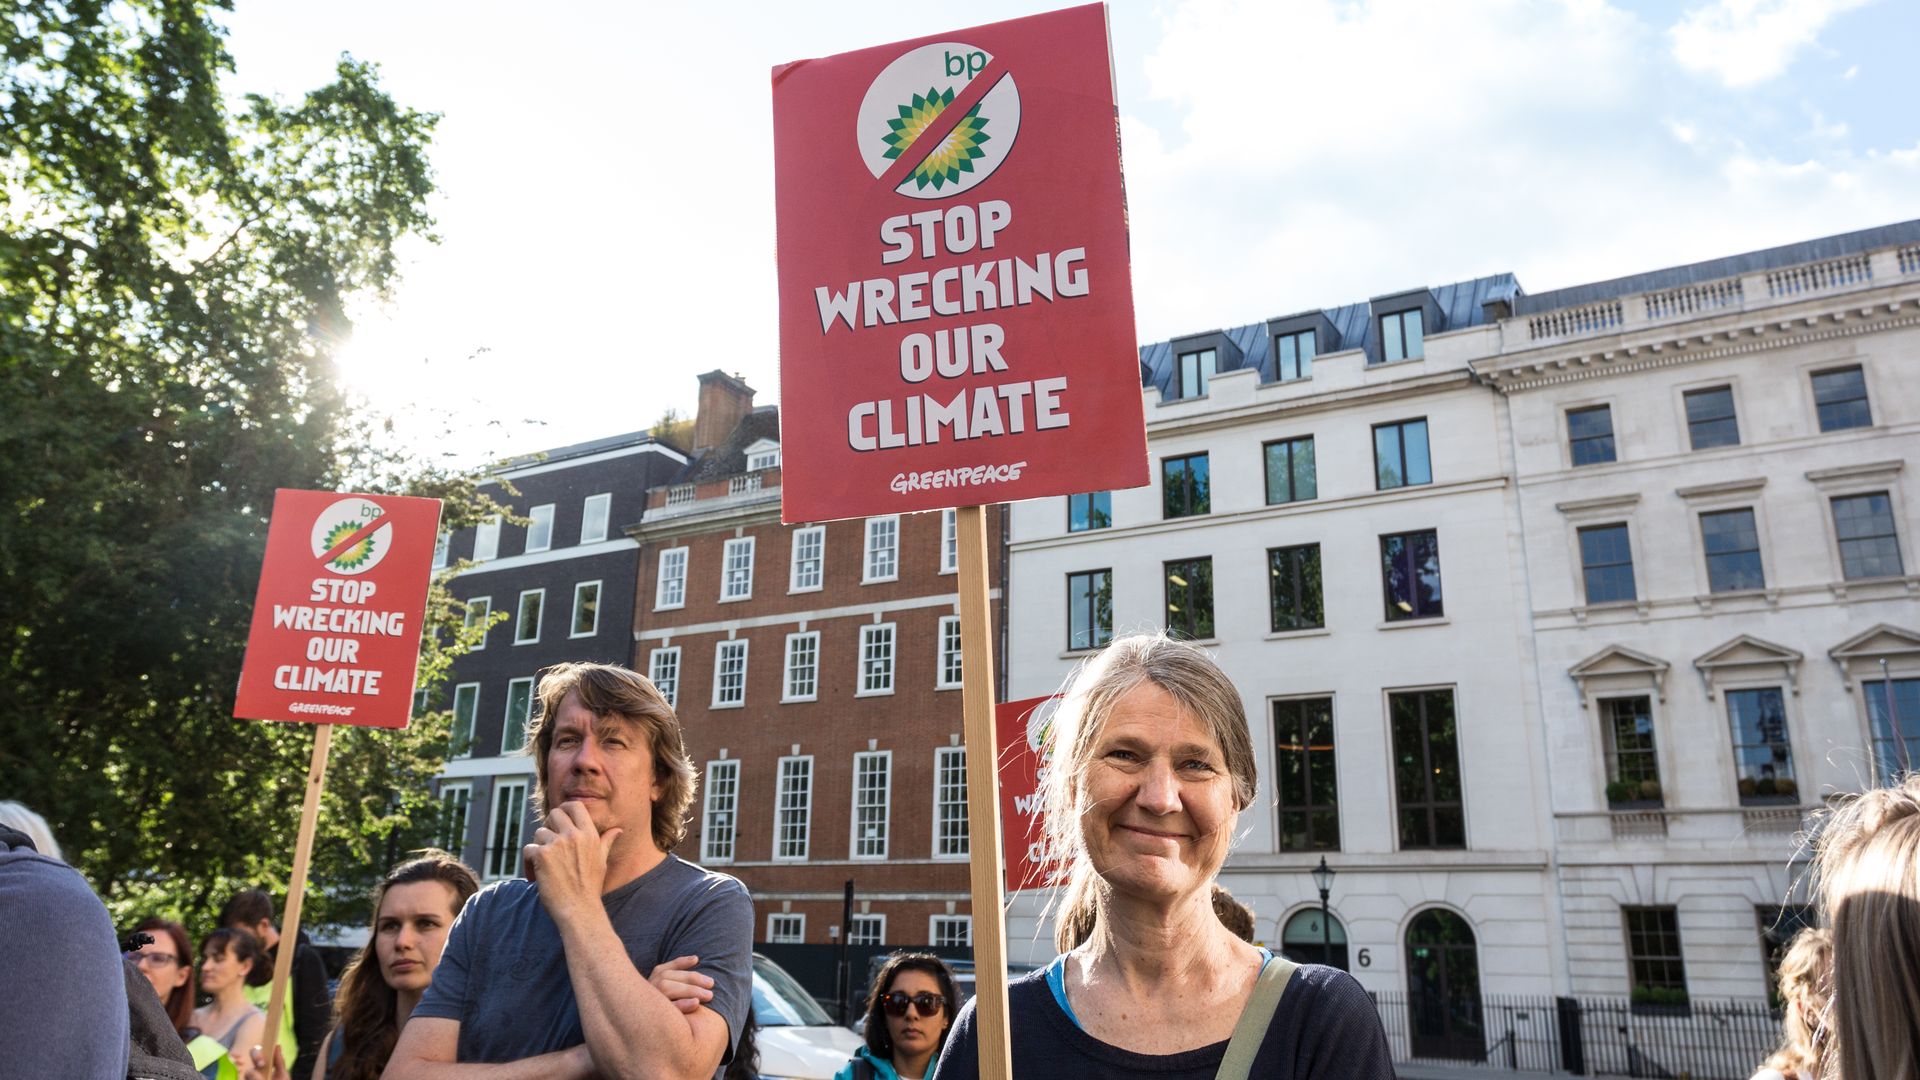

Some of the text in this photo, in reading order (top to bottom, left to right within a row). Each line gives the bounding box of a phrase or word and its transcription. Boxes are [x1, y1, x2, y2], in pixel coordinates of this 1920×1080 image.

[944, 50, 987, 80] bp
[880, 200, 1012, 264] STOP
[815, 247, 1090, 335] WRECKING
[900, 324, 1009, 383] OUR
[848, 377, 1070, 452] CLIMATE
[890, 462, 1027, 494] GREENPEACE
[360, 504, 382, 520] bp
[310, 578, 376, 604] STOP
[273, 605, 405, 637] WRECKING
[306, 637, 360, 663] OUR
[274, 665, 382, 695] CLIMATE
[288, 702, 355, 716] GREENPEACE
[1311, 921, 1319, 932] 6
[1358, 948, 1371, 968] 6
